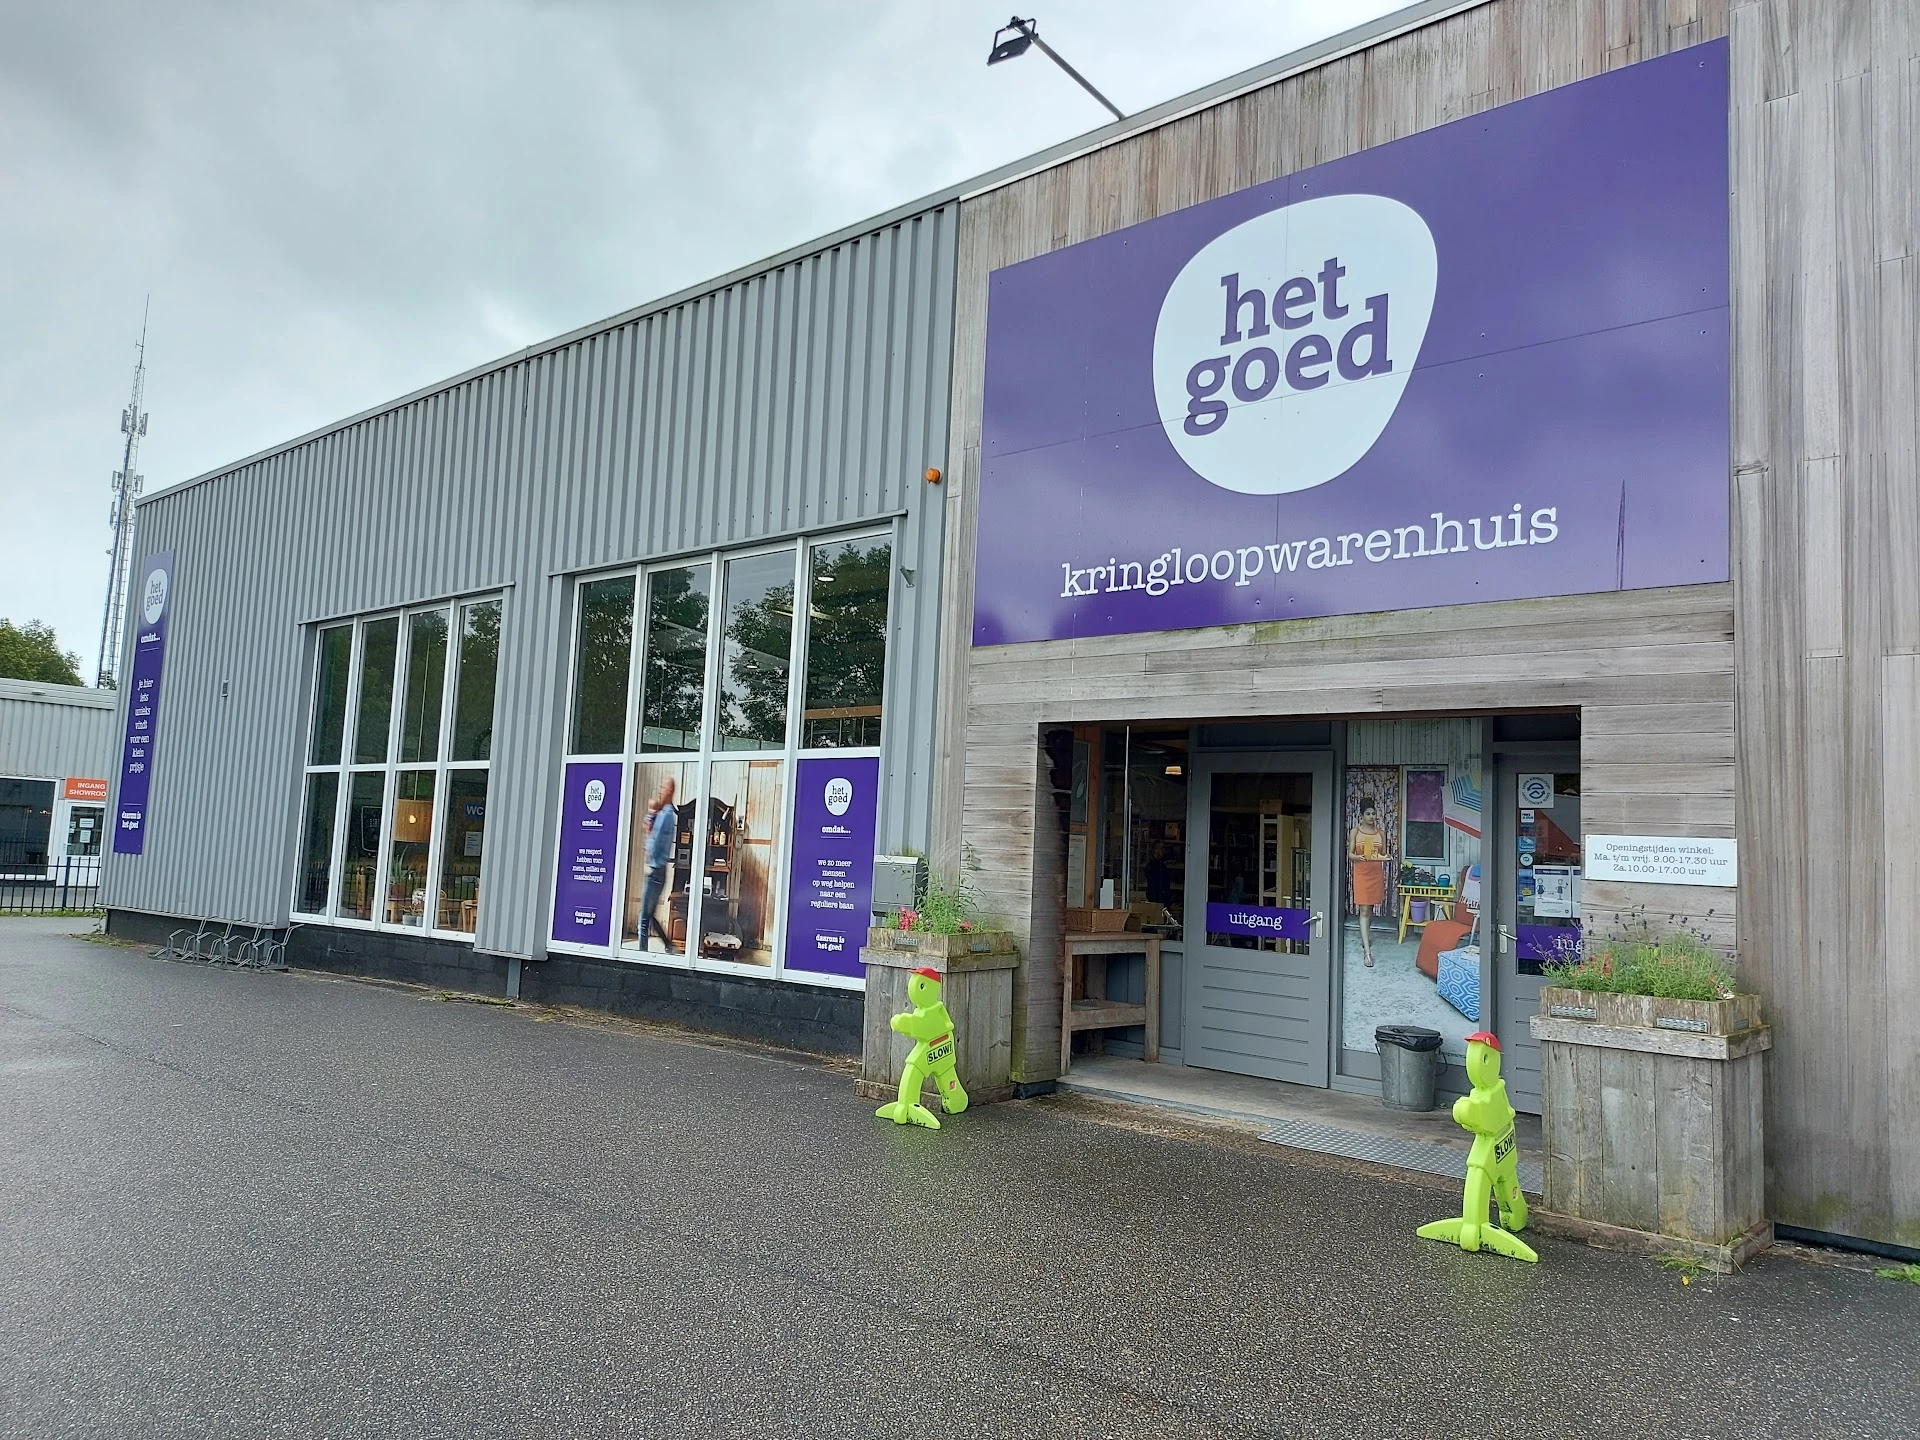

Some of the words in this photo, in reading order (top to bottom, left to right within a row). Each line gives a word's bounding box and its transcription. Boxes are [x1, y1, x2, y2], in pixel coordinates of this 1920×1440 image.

[1219, 256, 1349, 347] het
[1183, 293, 1393, 437] goed
[1060, 503, 1559, 598] kringloopwarenhuis
[150, 580, 162, 595] het
[146, 589, 164, 611] goed
[129, 735, 141, 744] voor
[131, 747, 145, 758] klein
[77, 782, 106, 790] INGANG
[590, 785, 600, 795] het
[832, 784, 845, 795] het
[587, 791, 602, 804] goed
[828, 792, 848, 806] goed
[466, 804, 484, 816] WC
[821, 824, 852, 834] omdat...
[1606, 843, 1676, 854] Openingstijden
[1678, 845, 1714, 855] winkel:
[835, 860, 852, 868] meer
[1593, 852, 1611, 861] Ma.
[1612, 853, 1630, 863] t/m
[1631, 854, 1651, 864] vrij.
[1653, 854, 1707, 865] 9.00-17.30
[1688, 868, 1707, 876] uur
[812, 879, 821, 888] op
[820, 880, 833, 889] weg
[833, 879, 855, 890] helpen
[819, 890, 835, 898] naar
[834, 891, 847, 899] een
[810, 900, 838, 909] reguliere
[838, 901, 855, 910] baan
[1228, 911, 1283, 931] uitgang
[815, 933, 838, 943] daarom
[838, 935, 845, 944] is
[817, 941, 828, 950] het
[828, 943, 843, 951] goed
